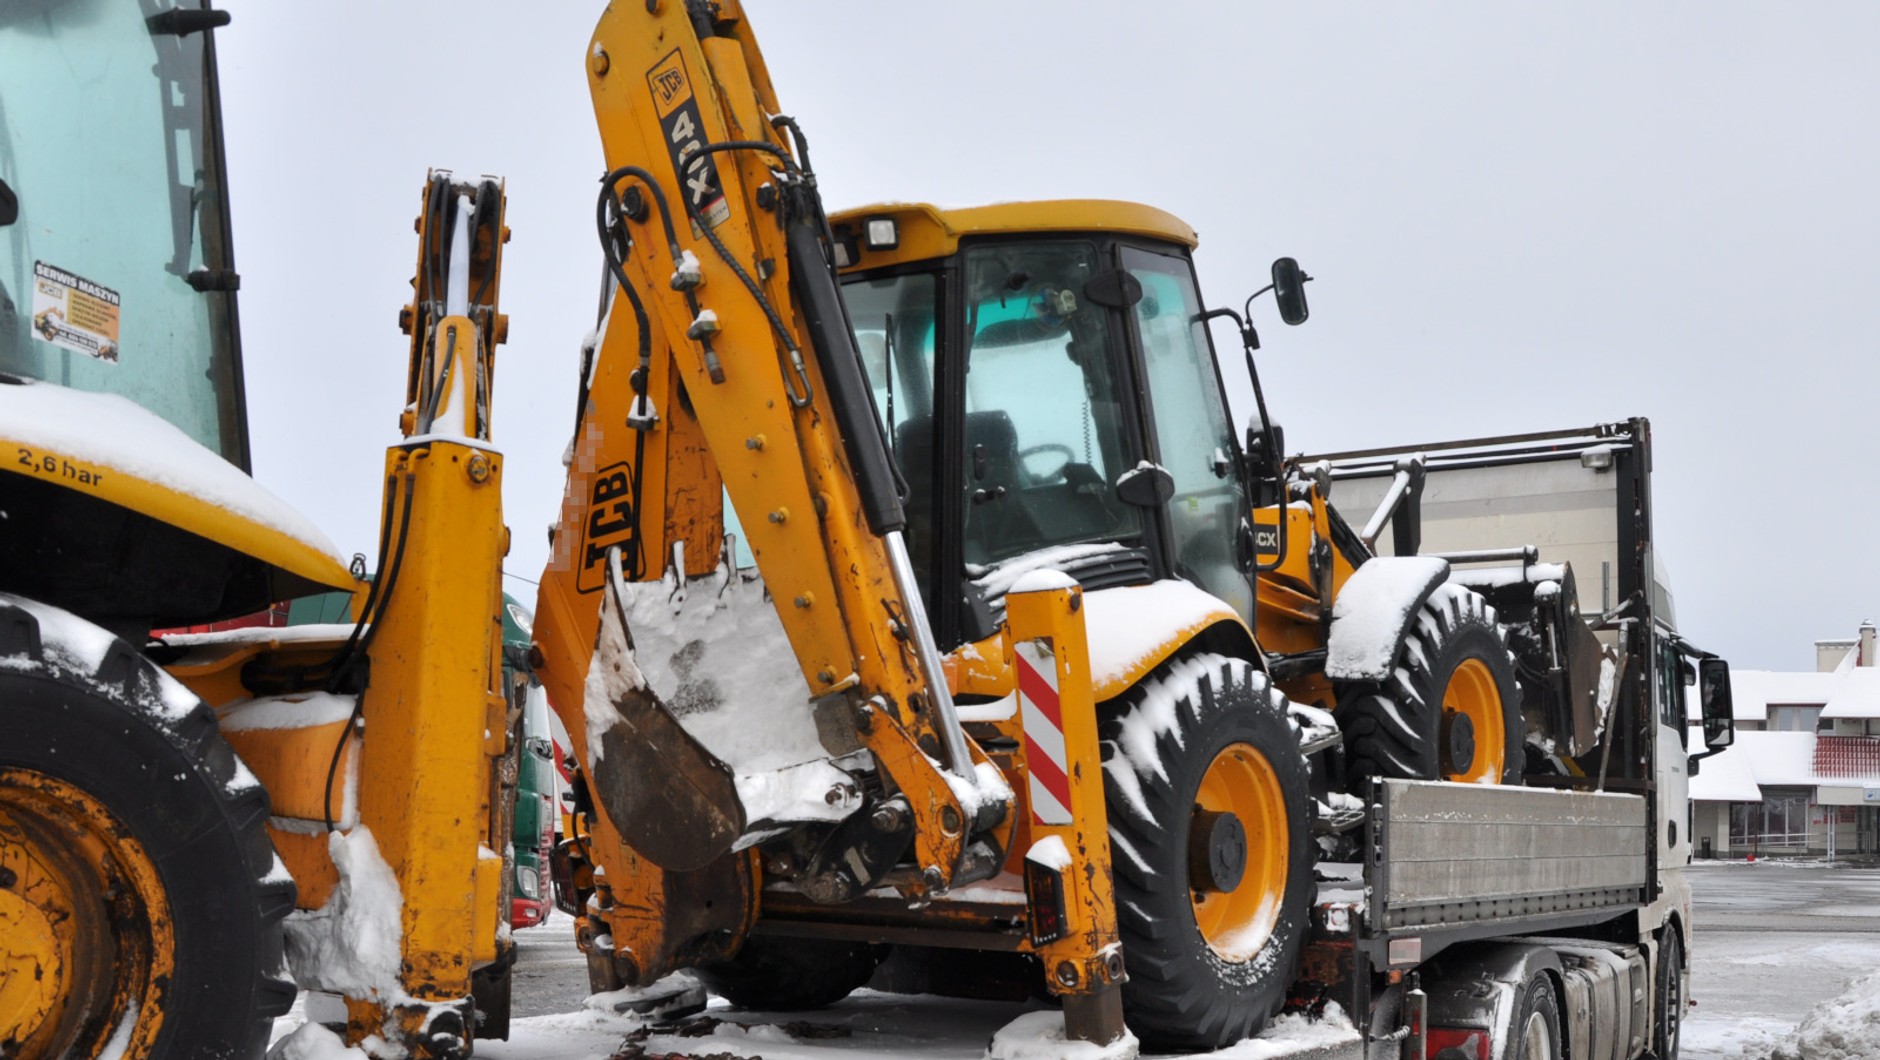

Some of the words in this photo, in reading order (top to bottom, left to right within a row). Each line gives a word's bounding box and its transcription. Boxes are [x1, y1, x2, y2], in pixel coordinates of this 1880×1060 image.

[659, 70, 683, 101] JCB
[36, 263, 77, 289] SERWIS
[79, 280, 119, 305] MASZYN
[41, 285, 62, 298] JCB
[18, 448, 56, 474] 2,6
[584, 471, 633, 572] JCB
[1256, 532, 1276, 547] CX
